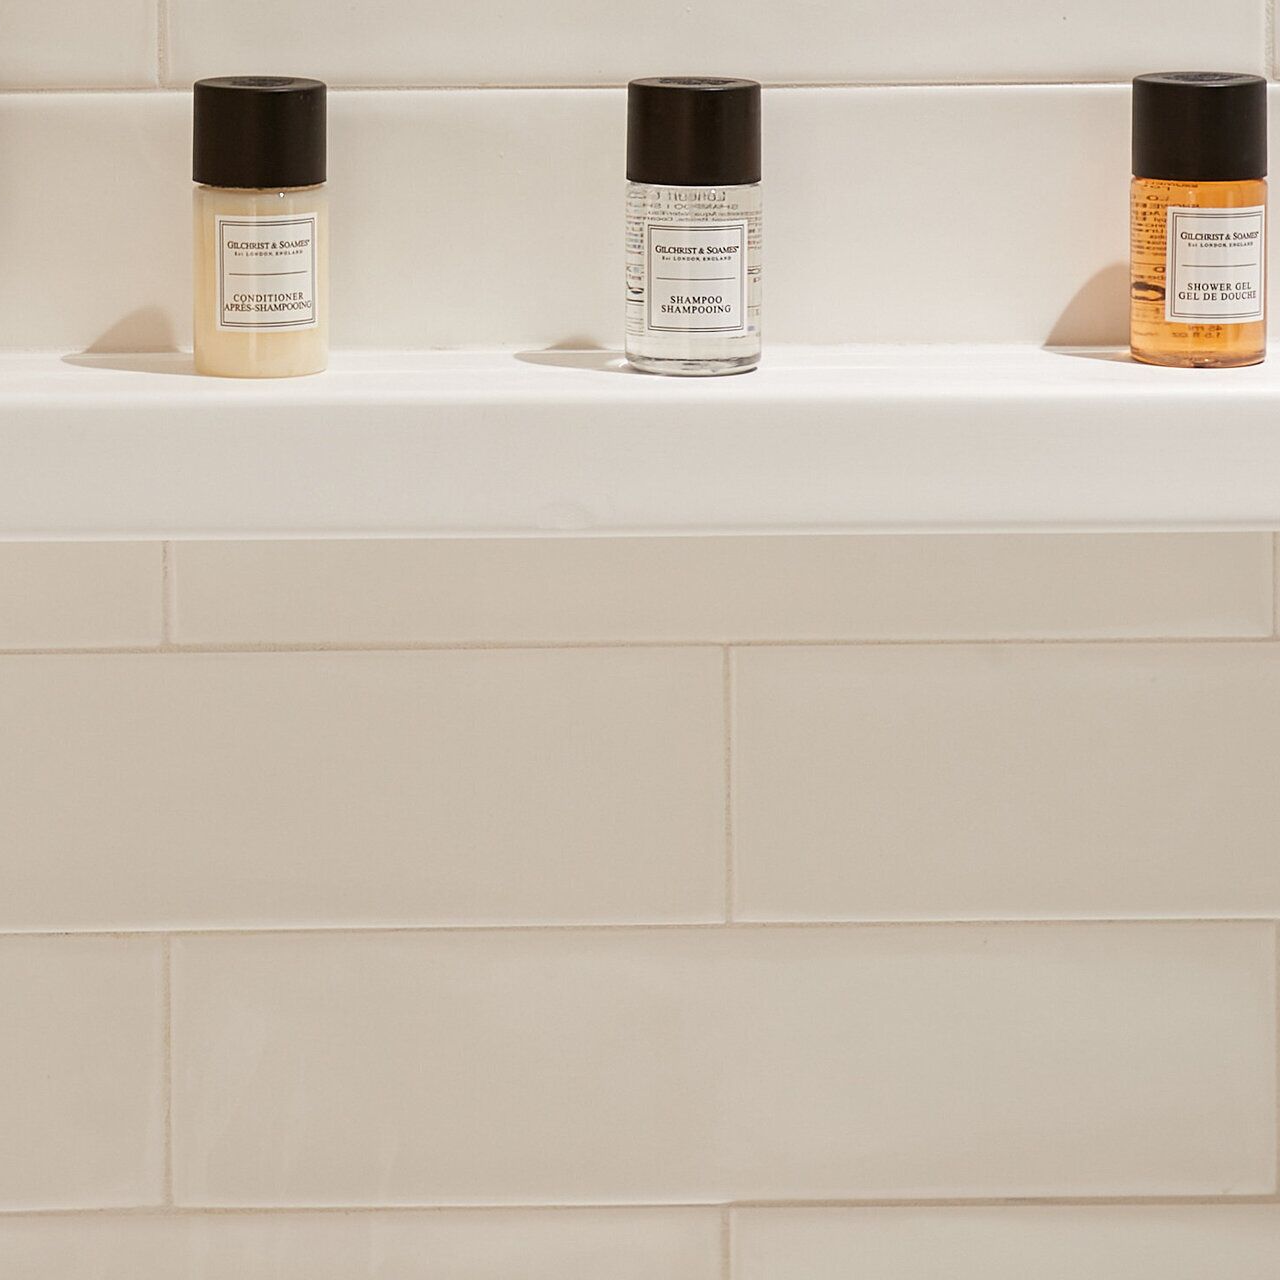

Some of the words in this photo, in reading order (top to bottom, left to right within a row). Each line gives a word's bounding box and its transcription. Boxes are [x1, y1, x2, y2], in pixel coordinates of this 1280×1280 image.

[271, 242, 277, 250] &
[1187, 282, 1232, 291] SHOWER
[1235, 282, 1251, 291] GEL
[233, 292, 304, 302] CONDITIONER
[670, 295, 723, 304] SHAMPOO
[1178, 291, 1200, 301] GEL
[1203, 292, 1217, 301] DE
[1221, 290, 1256, 301] DOUCHE
[661, 304, 731, 314] SHAMPOOING
